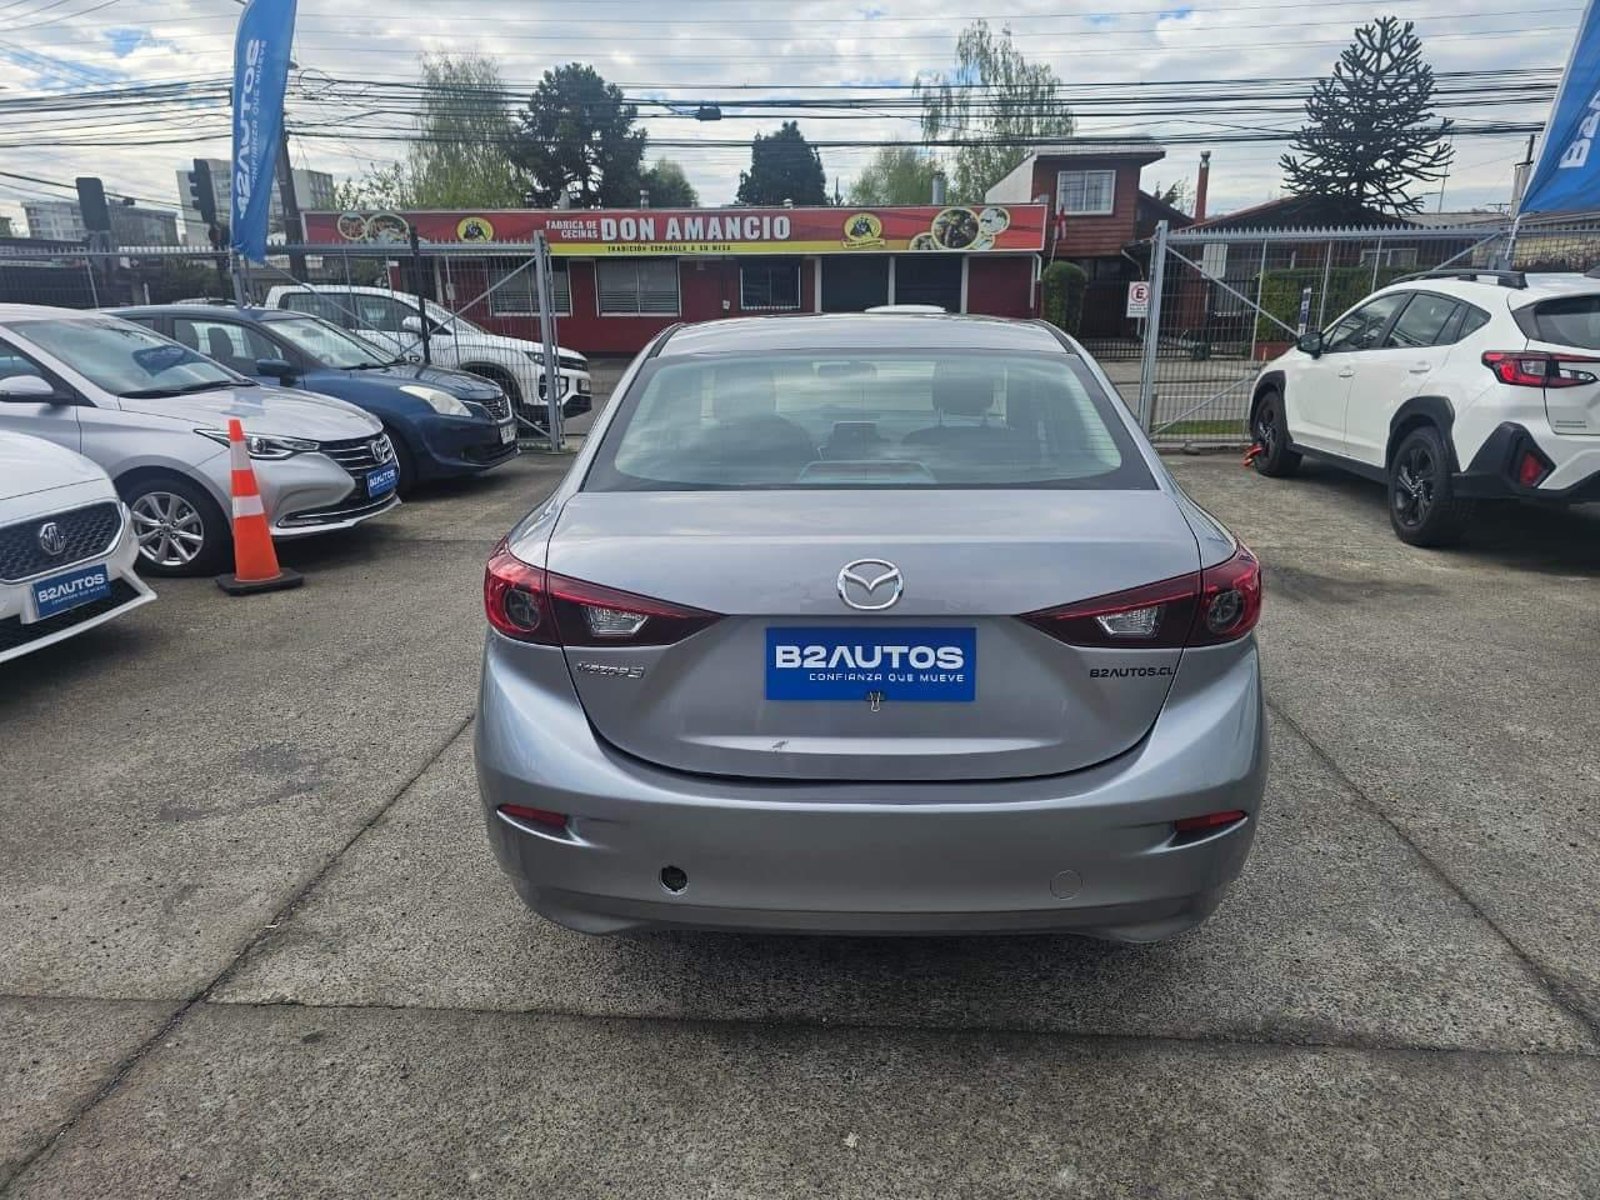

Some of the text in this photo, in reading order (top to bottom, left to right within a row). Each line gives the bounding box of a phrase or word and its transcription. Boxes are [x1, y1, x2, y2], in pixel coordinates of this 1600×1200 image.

[546, 220, 598, 230] FABRICA DE
[600, 216, 790, 241] DON AMANCIO
[561, 229, 598, 239] CECINAS
[1136, 288, 1144, 299] E
[38, 573, 105, 603] B2AUTOS
[775, 645, 964, 670] B2AUTOS
[809, 673, 965, 682] CONFIANZA QUE MUEVE
[1090, 667, 1173, 678] B2AUTOS.CL
